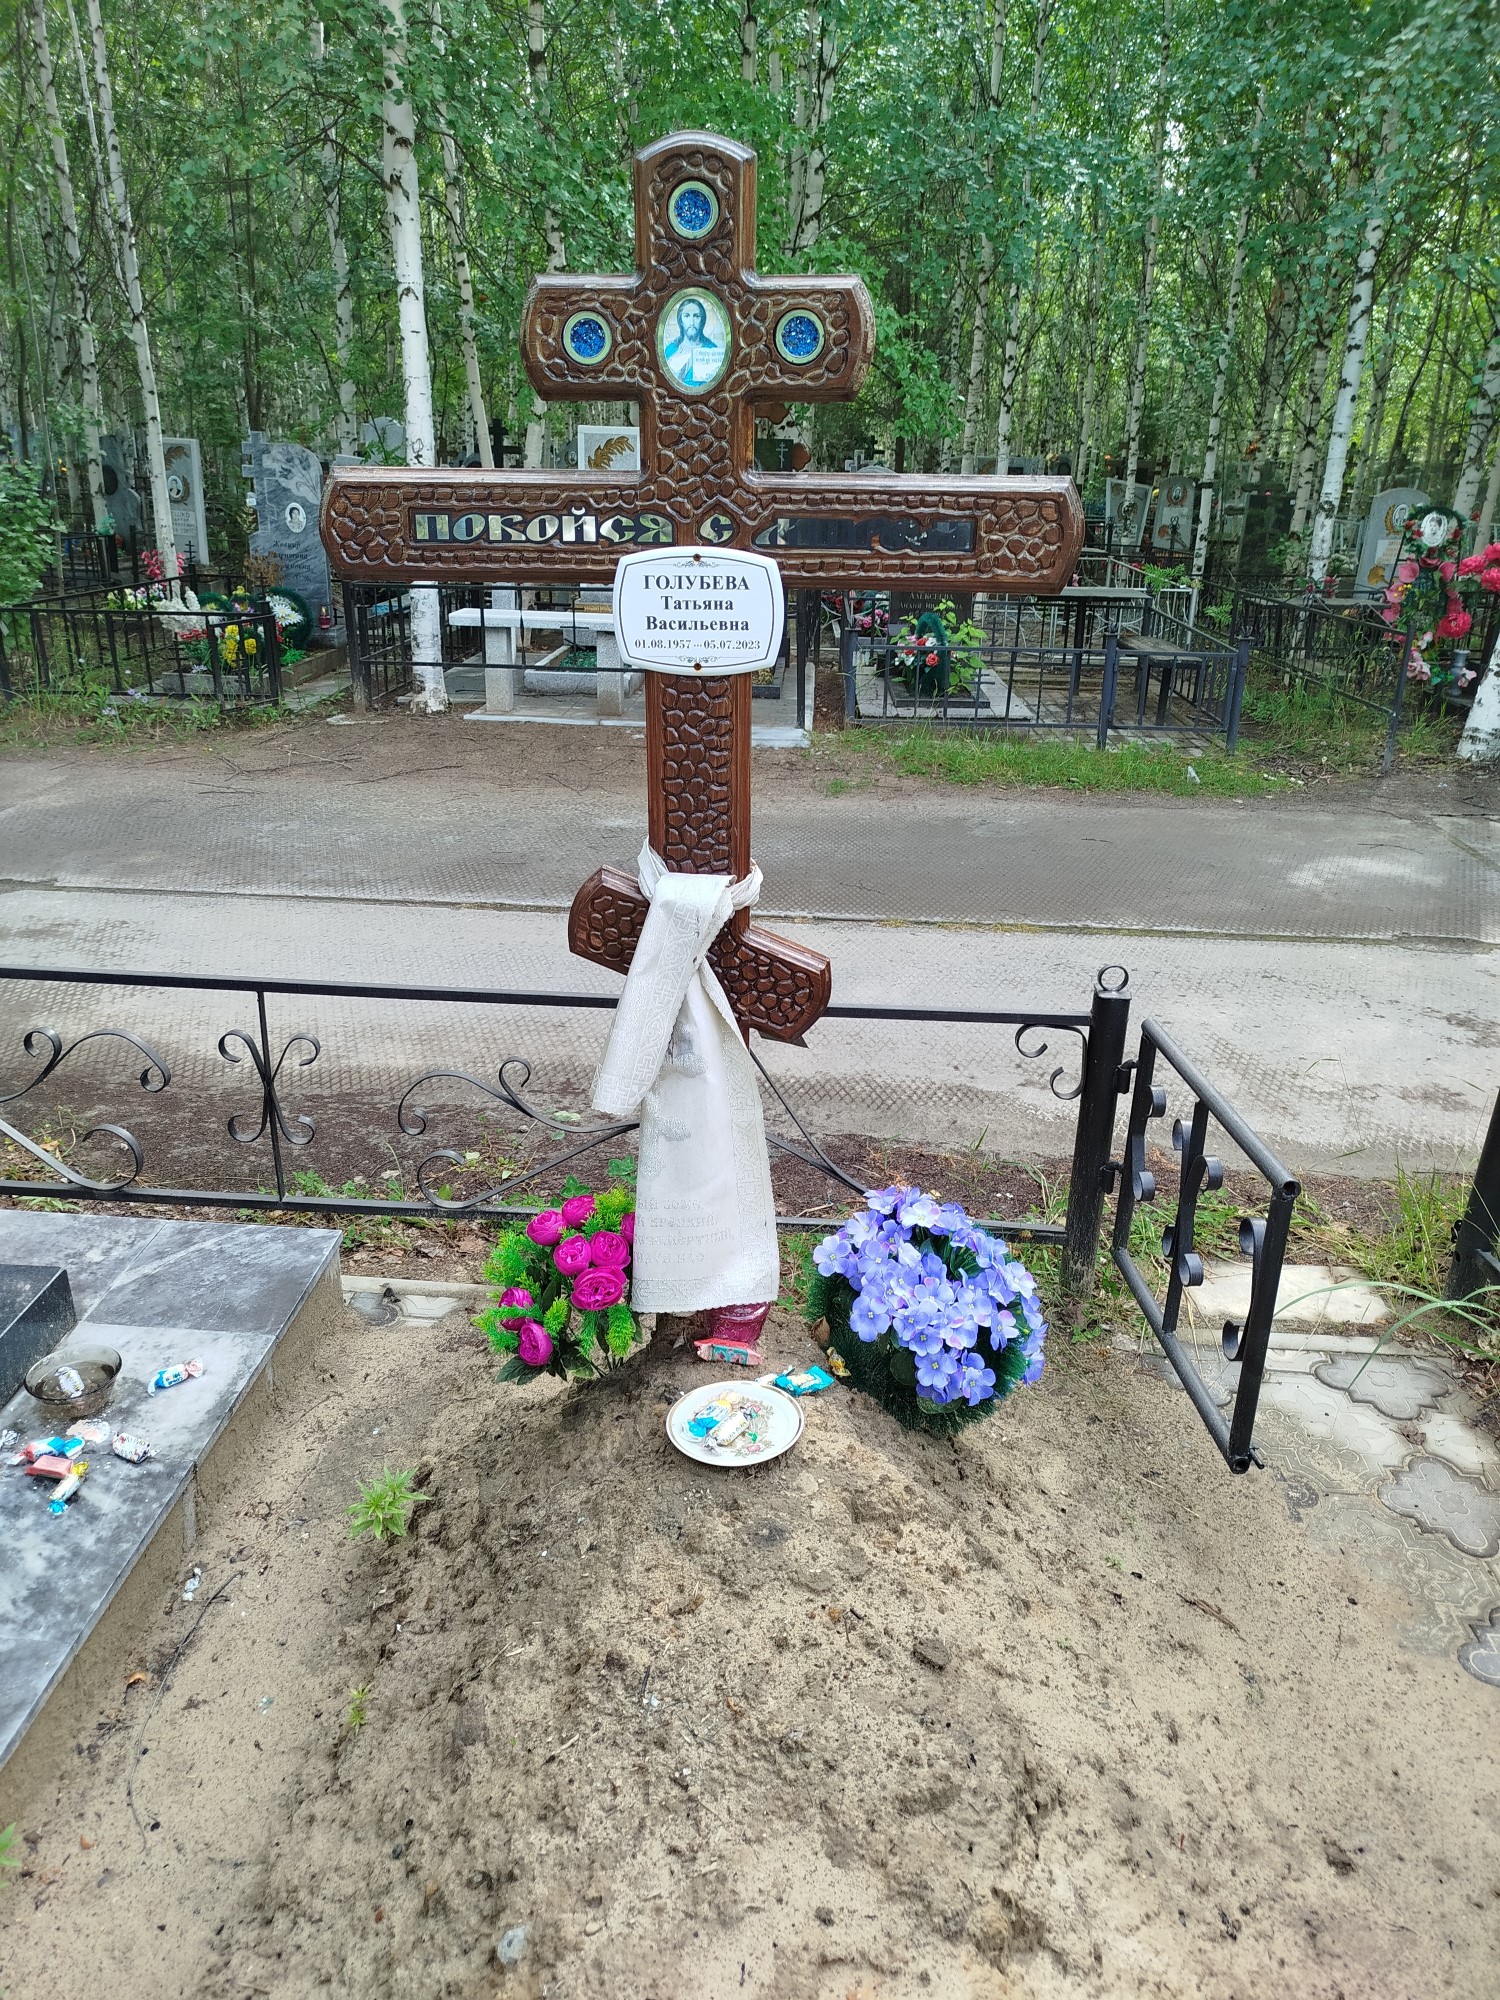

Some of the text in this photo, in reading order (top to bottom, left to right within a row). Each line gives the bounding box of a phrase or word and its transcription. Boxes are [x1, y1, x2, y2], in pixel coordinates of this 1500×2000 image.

[643, 575, 750, 590] ГОЛУБЕВА
[661, 595, 734, 611] Татьяна
[645, 615, 750, 631] Васильевна
[634, 639, 692, 649] 01.08.1957
[703, 640, 760, 650] 05.07.2023
